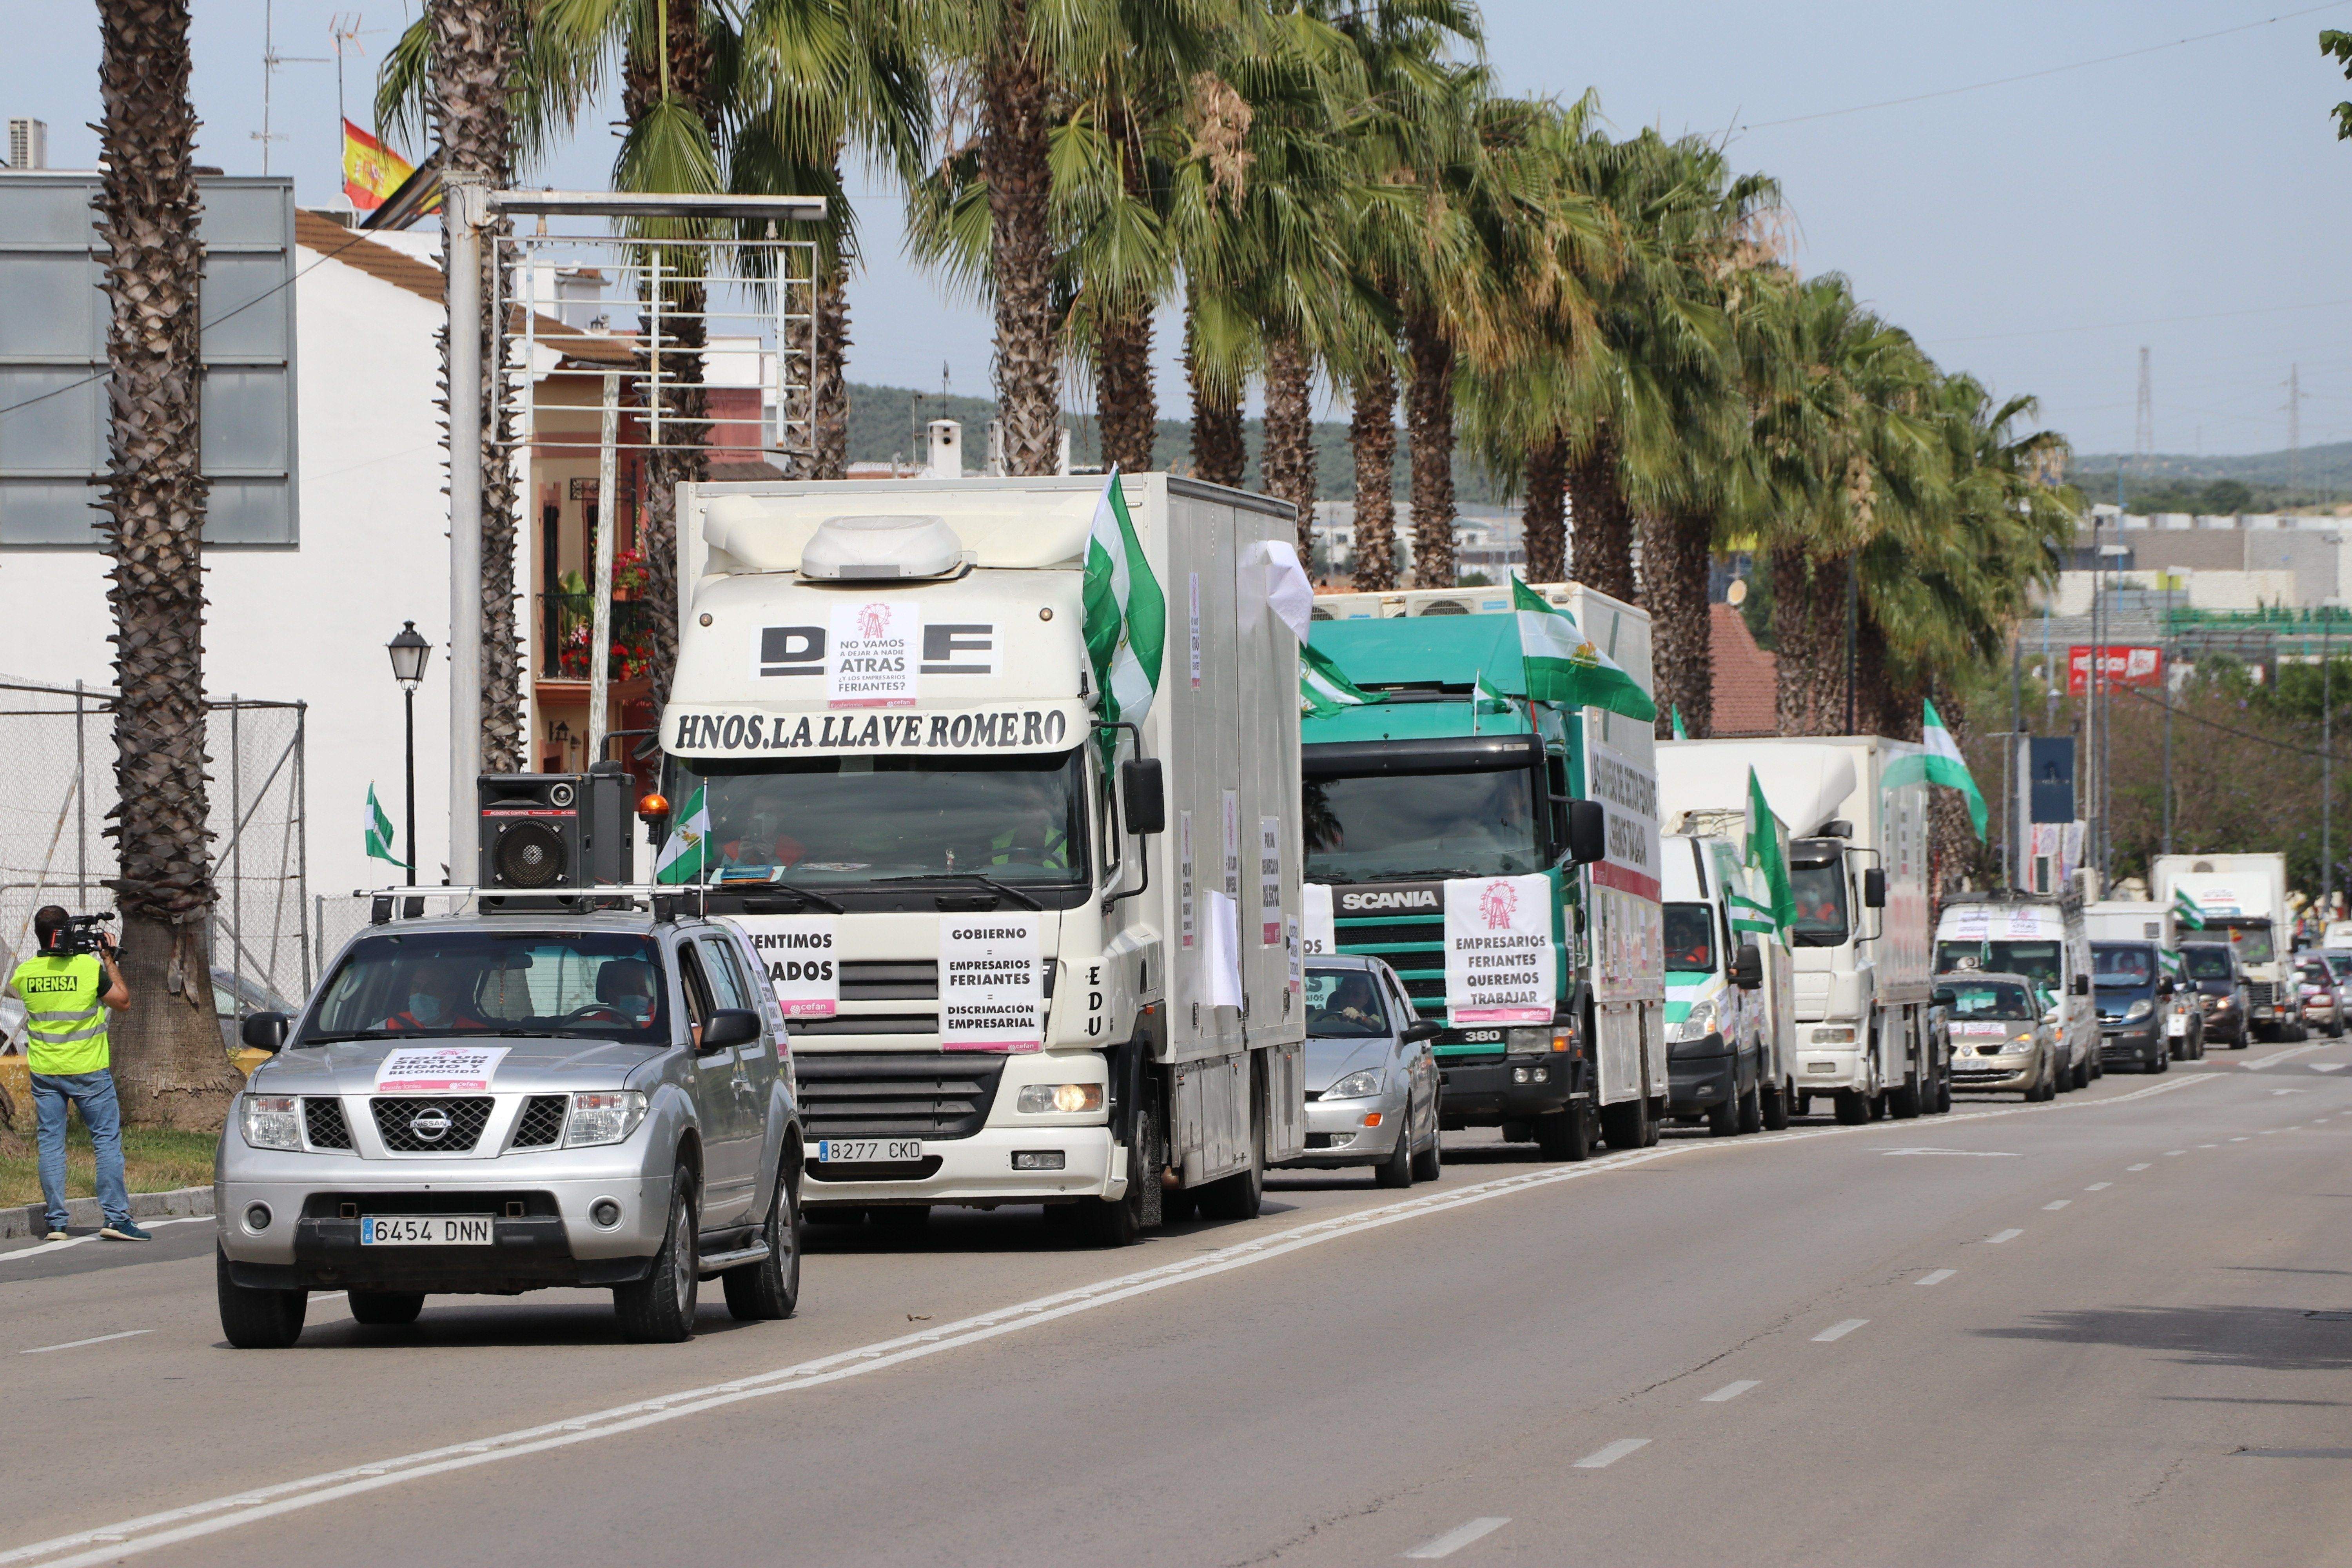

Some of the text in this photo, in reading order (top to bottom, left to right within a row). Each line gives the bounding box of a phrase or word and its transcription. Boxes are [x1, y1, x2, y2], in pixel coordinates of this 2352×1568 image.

[840, 639, 904, 649] NO VAMOS
[839, 657, 905, 673] ATRAS
[838, 682, 906, 692] FERIANTES?
[818, 713, 922, 748] LLAVE
[926, 710, 1067, 748] ROMERO
[1342, 890, 1438, 910] SCANIA
[952, 927, 1027, 940] GOBIERNO
[1455, 935, 1546, 950] EMPRESARIOS
[949, 960, 1031, 971] EMPRESARIOS
[1468, 954, 1536, 968] FERIANTES
[28, 976, 76, 992] PRENSA
[950, 973, 1031, 986] FERIANTES
[1466, 972, 1539, 987] QUEREMOS
[1087, 965, 1102, 1036] EDU
[1470, 991, 1537, 1005] TRABAJAR
[947, 1002, 1034, 1014] DISCRIMACIÓN
[948, 1017, 1035, 1029] EMPRESARIAL
[1465, 1030, 1501, 1042] 380
[831, 1143, 878, 1159] 8277
[889, 1142, 920, 1158] CKD
[375, 1221, 432, 1241] 6454
[445, 1220, 487, 1241] DNN
